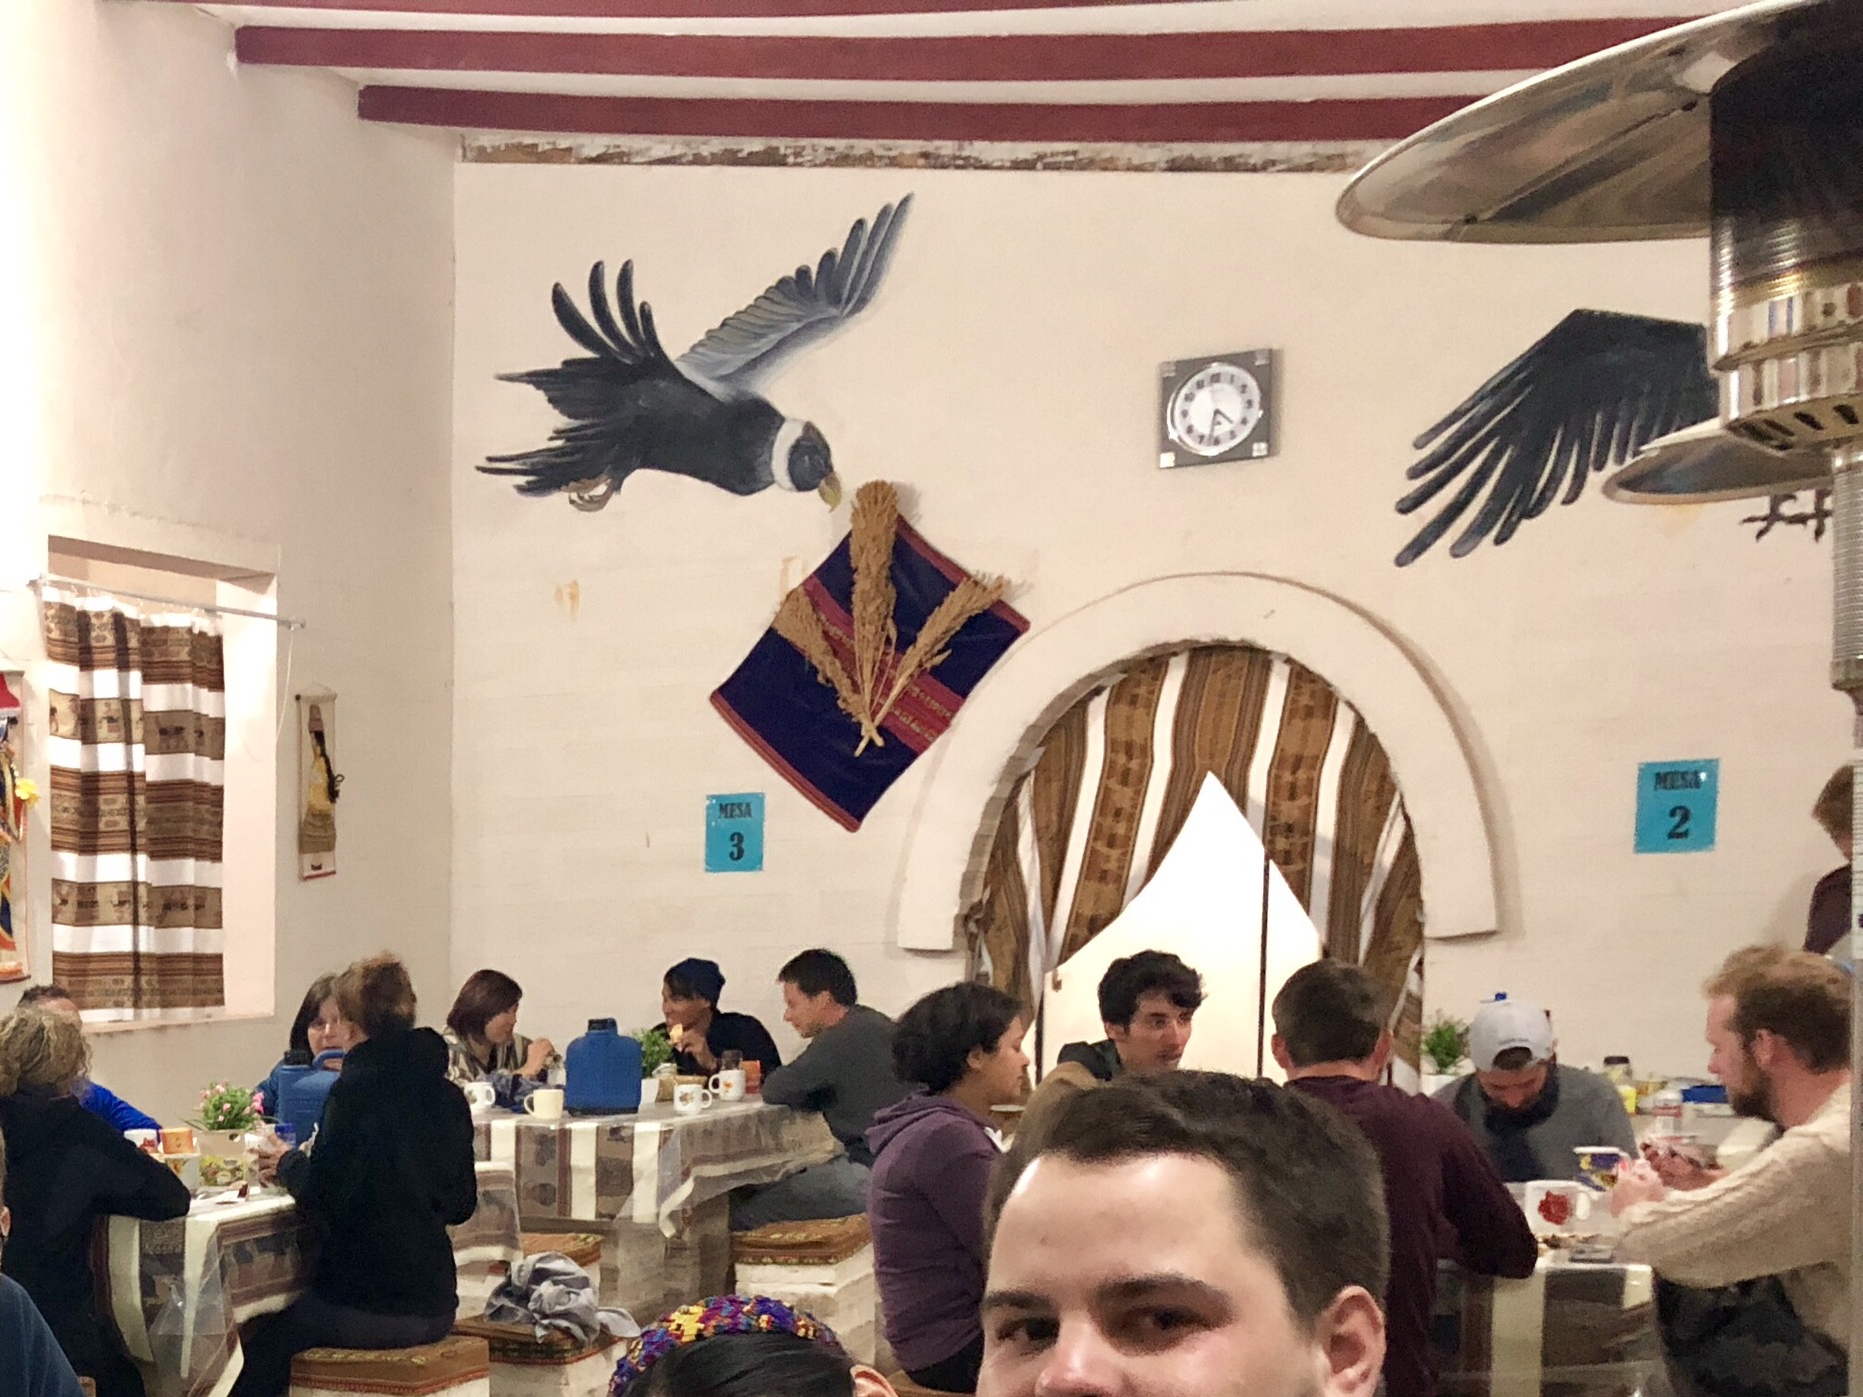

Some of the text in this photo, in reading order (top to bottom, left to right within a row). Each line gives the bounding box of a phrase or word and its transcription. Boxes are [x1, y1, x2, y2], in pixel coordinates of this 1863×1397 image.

[719, 802, 753, 819] MESA
[1668, 805, 1691, 840] 2
[729, 831, 745, 861] 3
